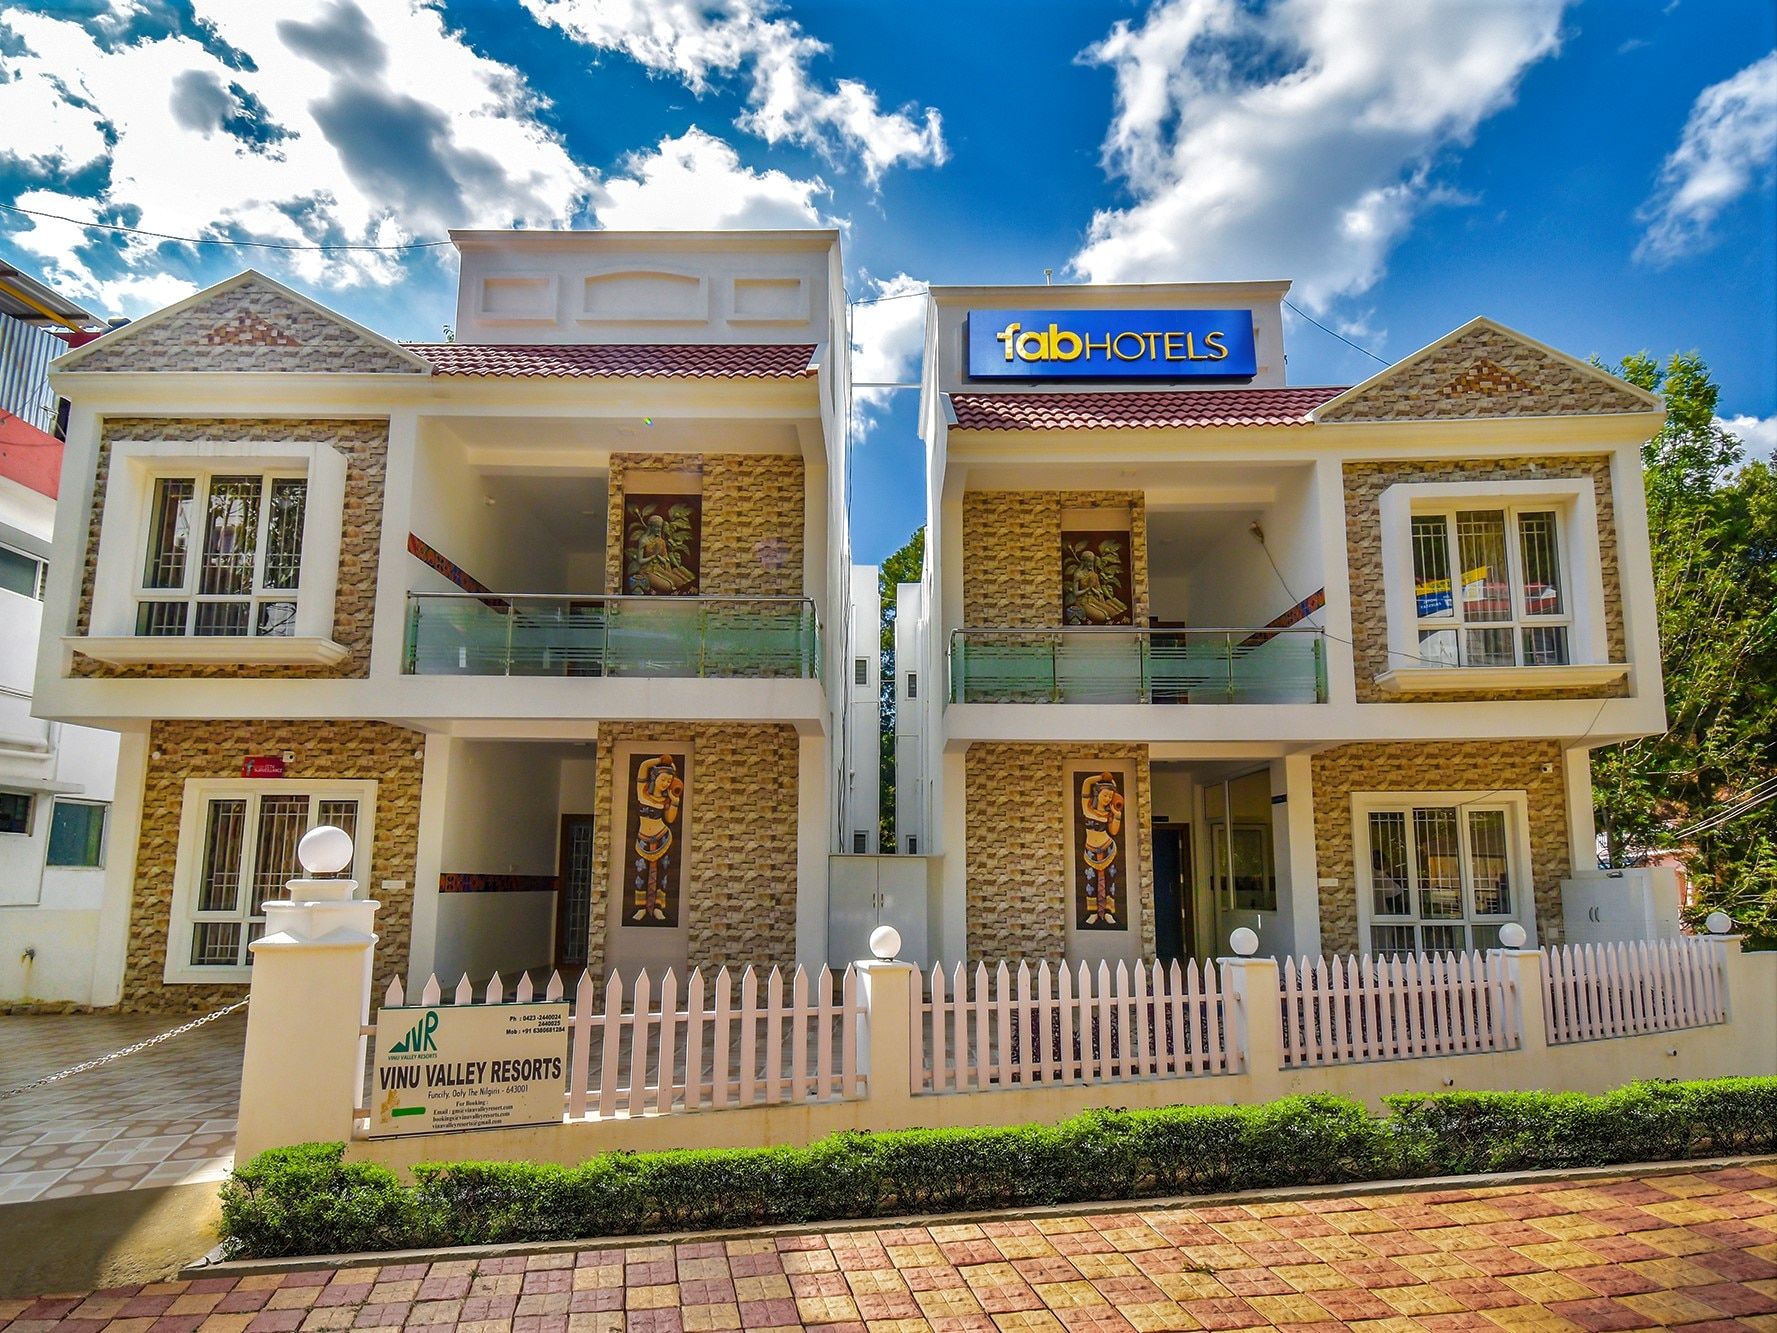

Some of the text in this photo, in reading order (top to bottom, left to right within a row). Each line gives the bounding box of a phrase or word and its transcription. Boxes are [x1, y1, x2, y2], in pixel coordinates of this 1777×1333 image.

[380, 1056, 562, 1090] VINU VALLEY RESORTS
[468, 1088, 478, 1096] The
[505, 1085, 529, 1094] 643001
